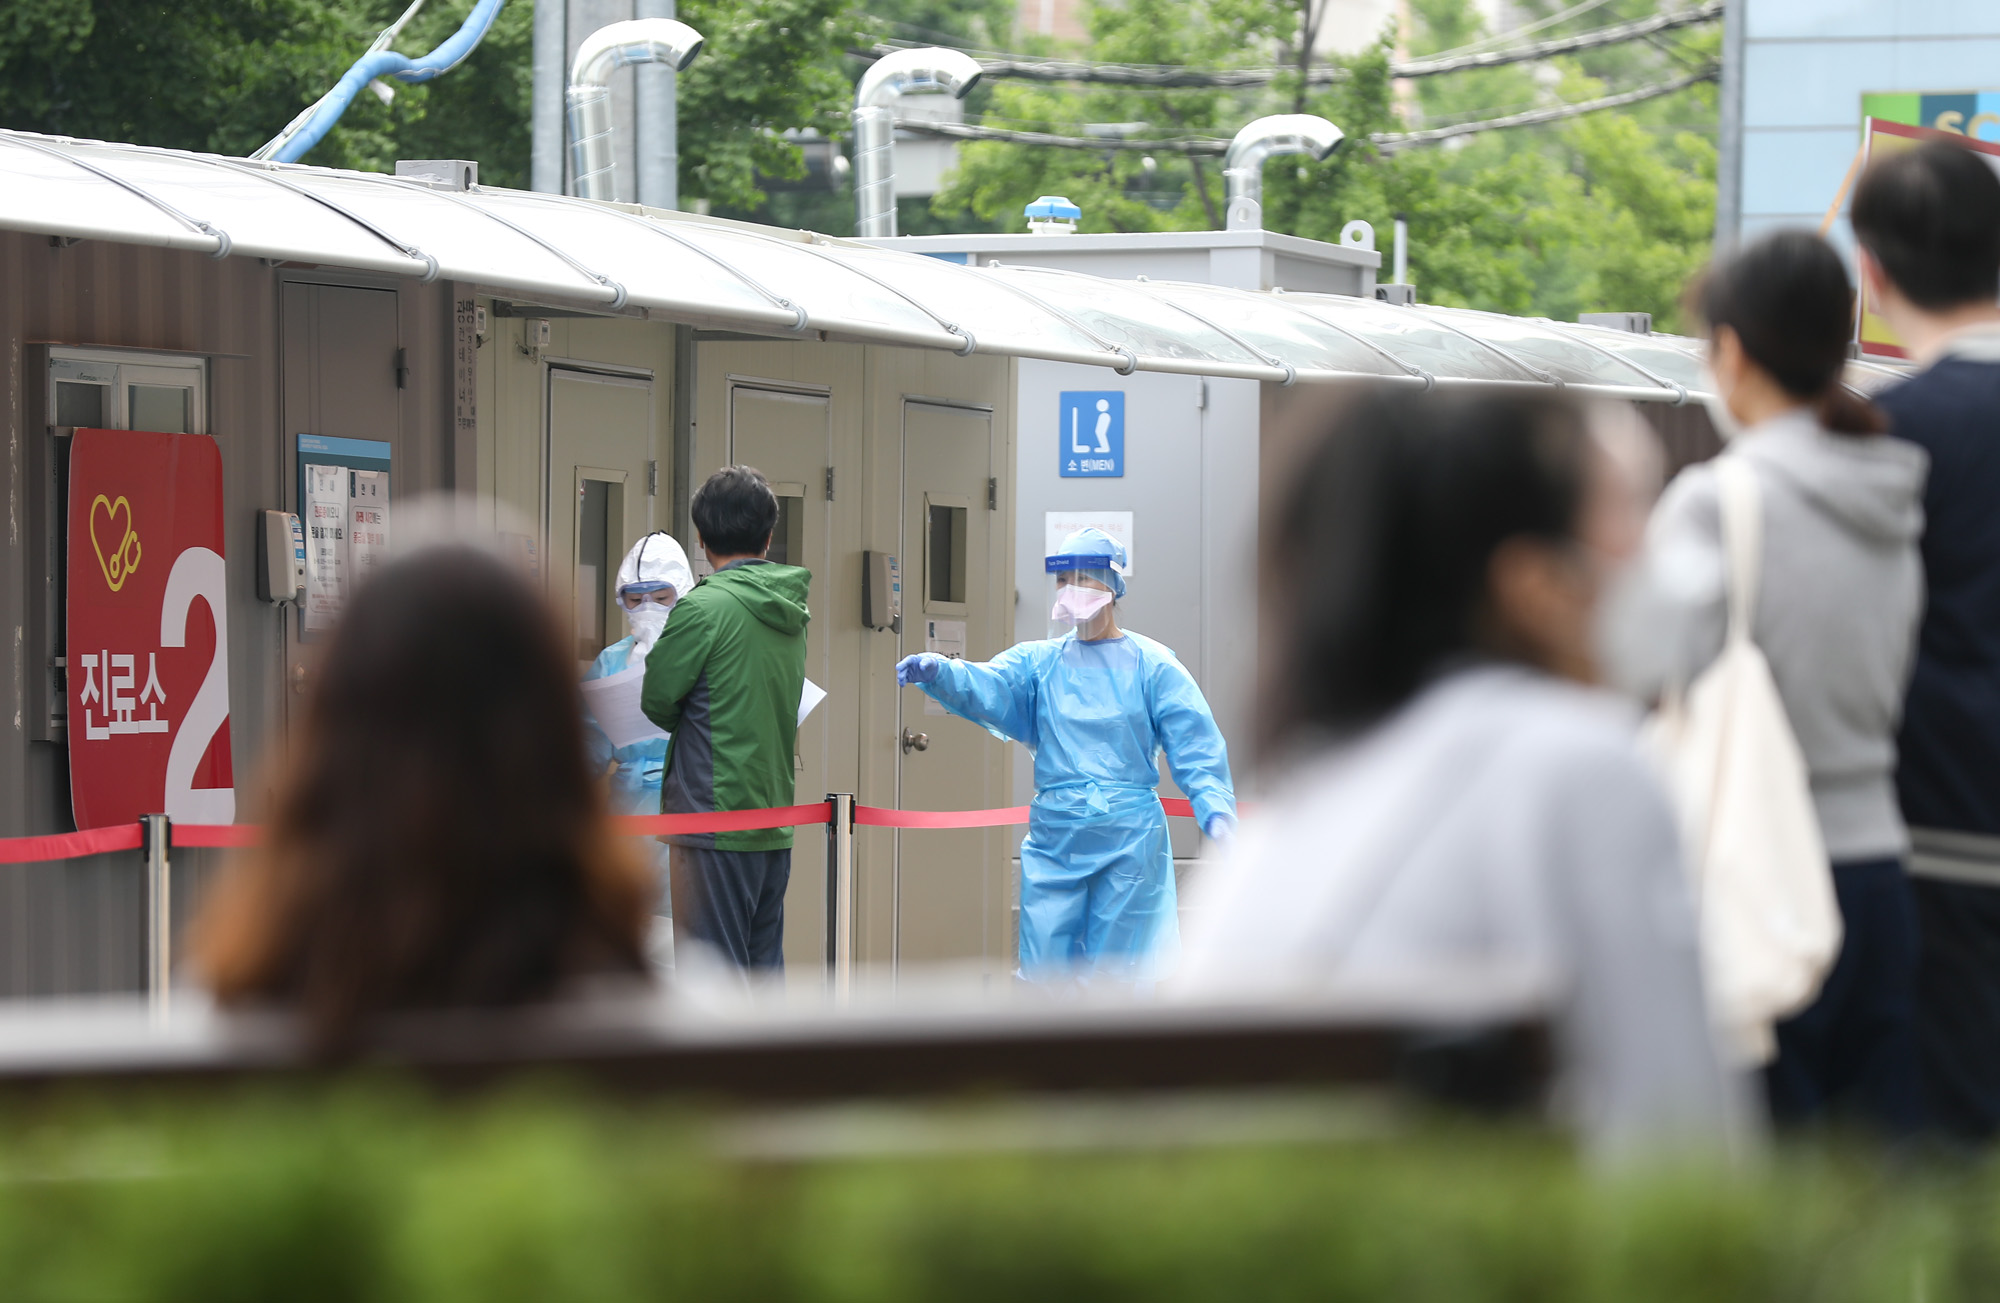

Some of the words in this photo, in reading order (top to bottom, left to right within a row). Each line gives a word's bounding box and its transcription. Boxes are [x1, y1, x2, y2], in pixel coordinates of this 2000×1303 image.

[1067, 460, 1077, 472] 소
[80, 649, 169, 741] 진료소
[160, 546, 236, 826] 2
